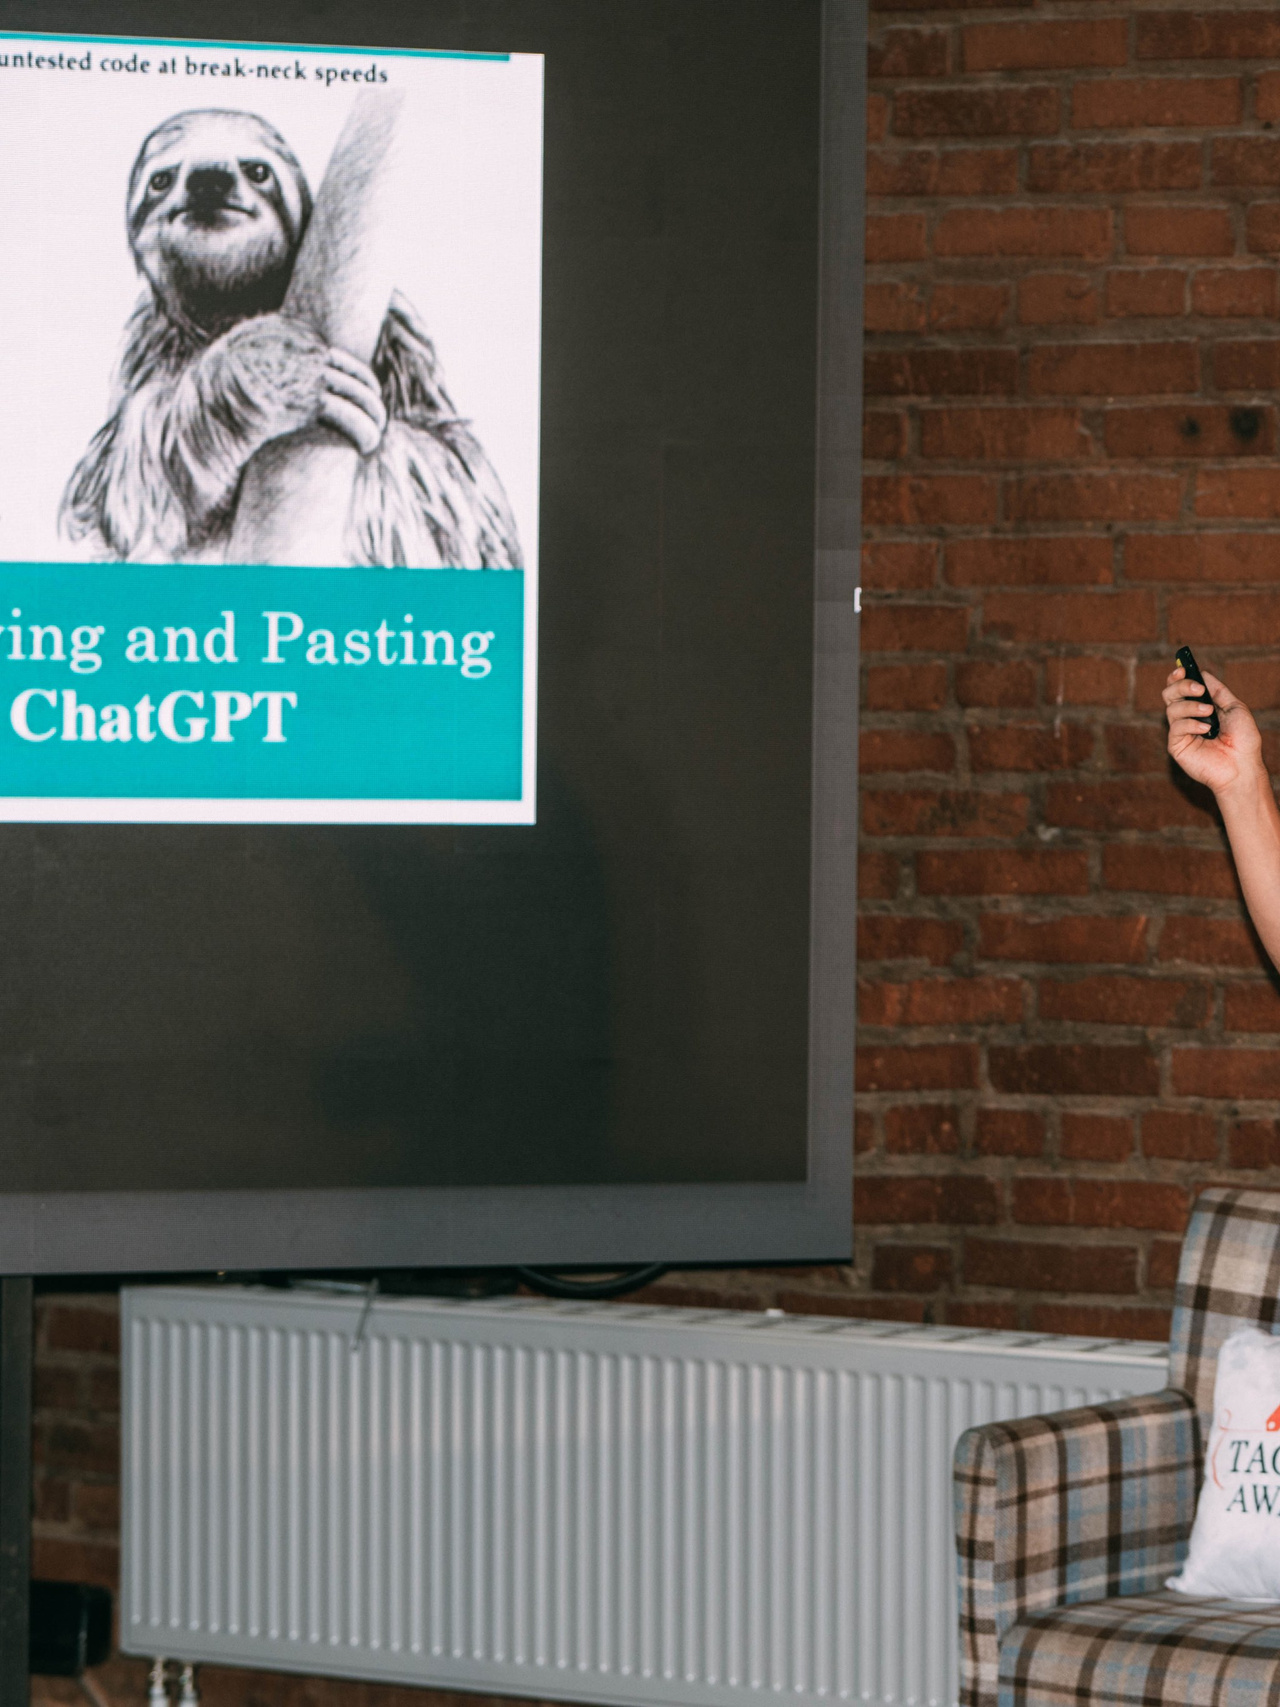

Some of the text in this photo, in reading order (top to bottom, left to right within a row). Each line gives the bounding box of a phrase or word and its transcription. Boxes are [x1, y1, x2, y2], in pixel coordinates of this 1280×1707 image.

[0, 50, 388, 87] untested code at break-neck speeds
[0, 608, 496, 679] ing and Pasting
[10, 688, 298, 743] ChatGPT
